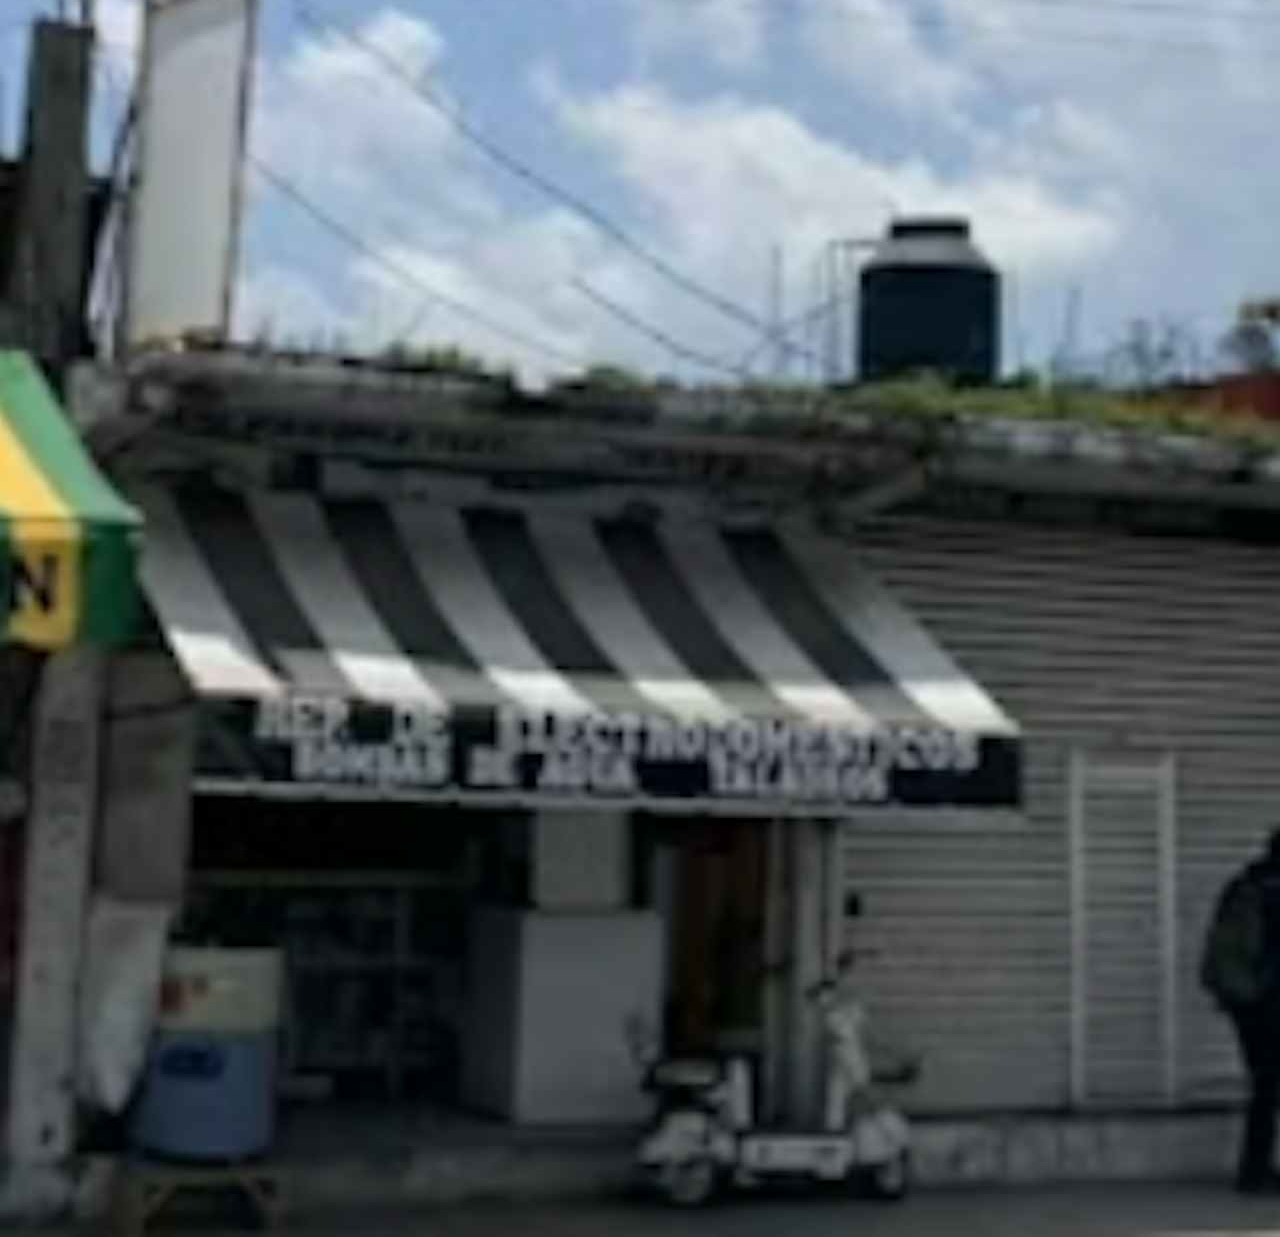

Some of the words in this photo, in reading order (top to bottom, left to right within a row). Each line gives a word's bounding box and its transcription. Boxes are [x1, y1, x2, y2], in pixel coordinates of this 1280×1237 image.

[392, 703, 453, 742] DE
[291, 743, 449, 785] BOMBAS
[468, 746, 517, 786] DE
[539, 752, 637, 791] AGUA
